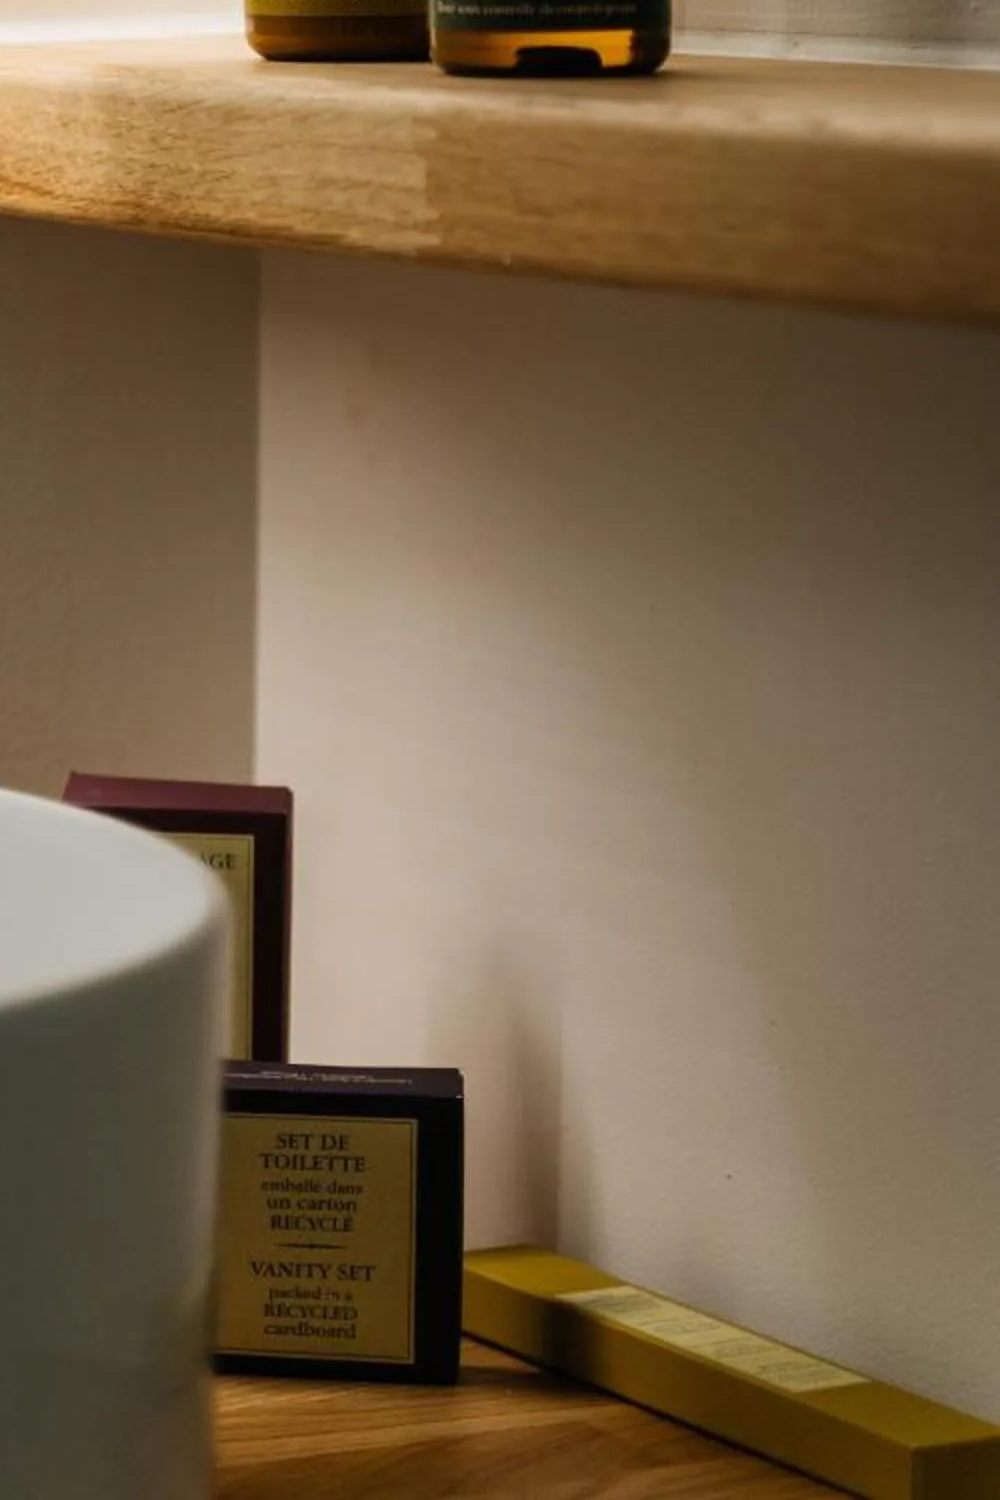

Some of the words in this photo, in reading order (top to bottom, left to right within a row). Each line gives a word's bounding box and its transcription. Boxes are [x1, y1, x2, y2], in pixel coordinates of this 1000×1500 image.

[275, 1133, 315, 1150] SET
[320, 1133, 350, 1151] DE
[259, 1152, 366, 1173] TOILETTE
[266, 1196, 292, 1210] un
[296, 1198, 357, 1213] carton
[250, 1261, 331, 1279] VANITY
[336, 1263, 377, 1282] SET
[263, 1303, 358, 1320] RECYCLED
[263, 1321, 357, 1340] cardboard
